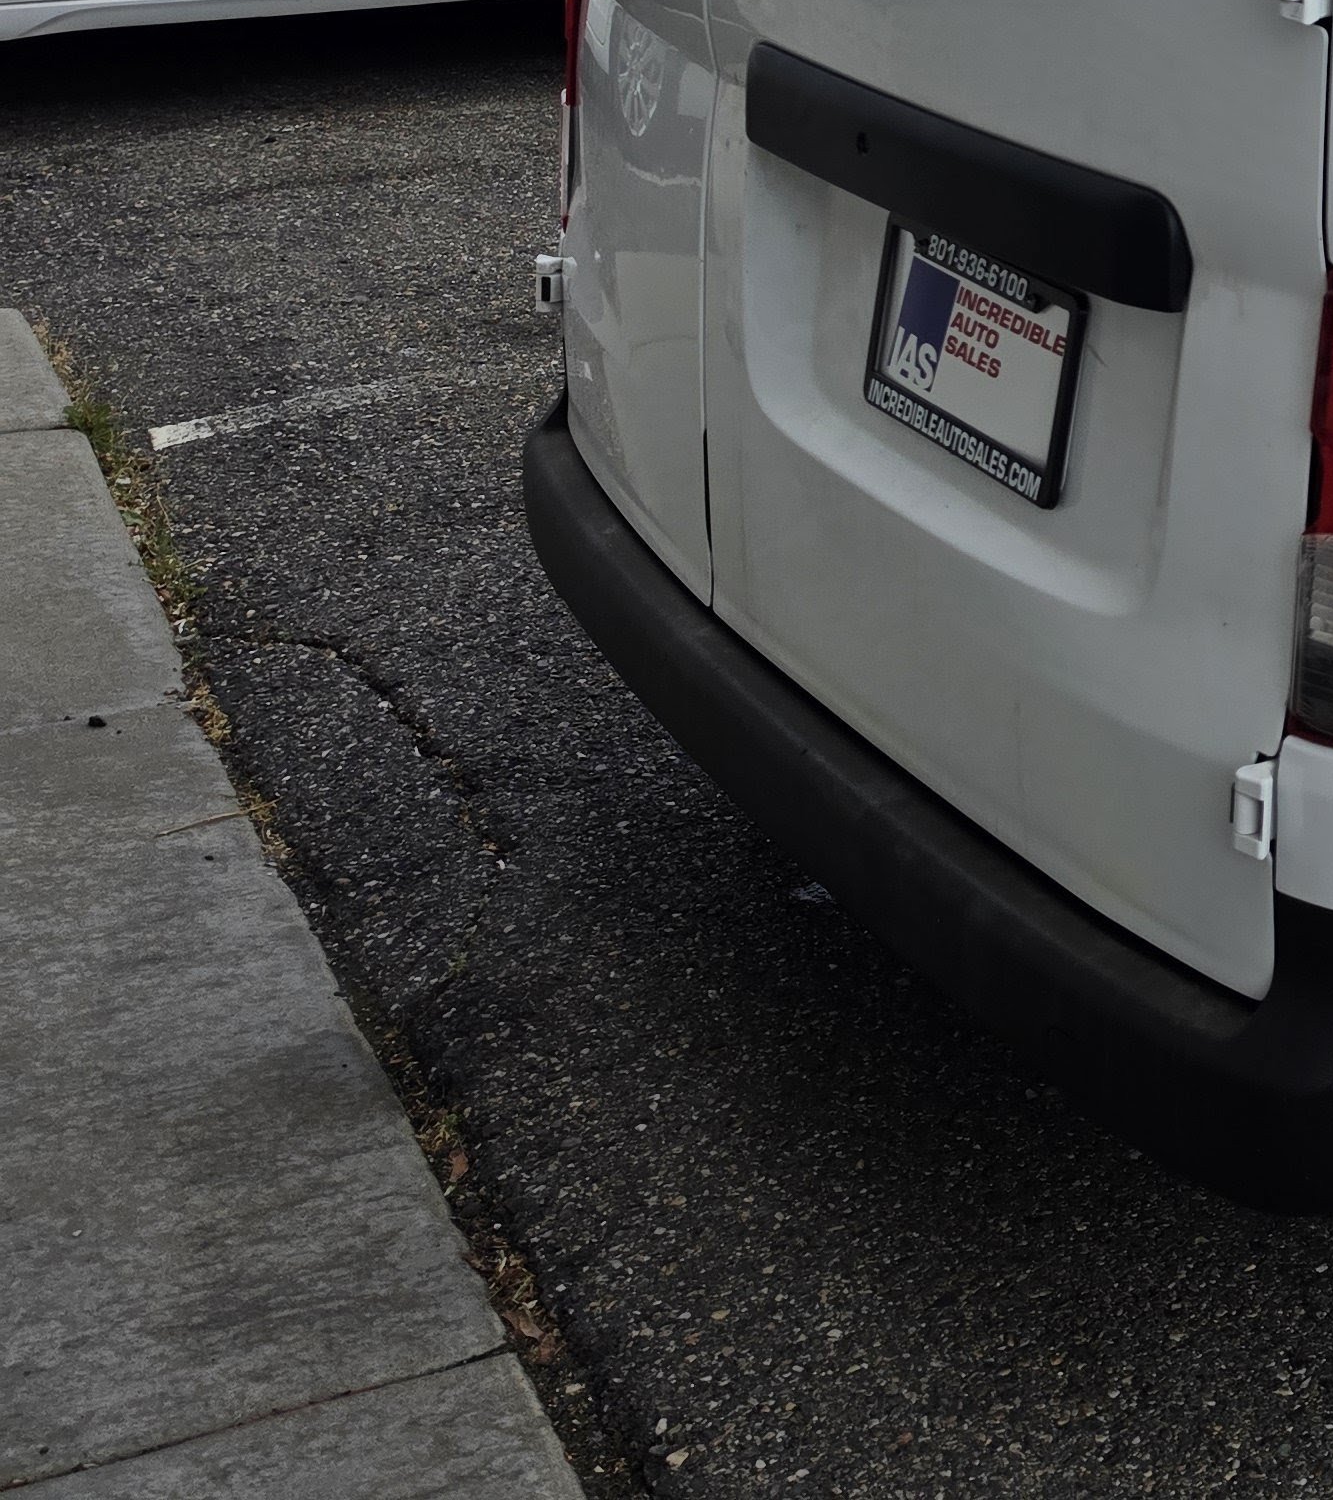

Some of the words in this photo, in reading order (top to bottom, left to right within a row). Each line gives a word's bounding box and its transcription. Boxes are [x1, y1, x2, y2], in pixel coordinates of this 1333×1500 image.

[928, 234, 1029, 302] 801-936-6100
[950, 311, 1000, 349] AUTO
[956, 286, 1068, 357] INCREDIBLE
[887, 325, 939, 391] IAS
[944, 334, 1002, 379] SALES
[867, 378, 1042, 501] INCREDIBLEAUTOSALES.COM
